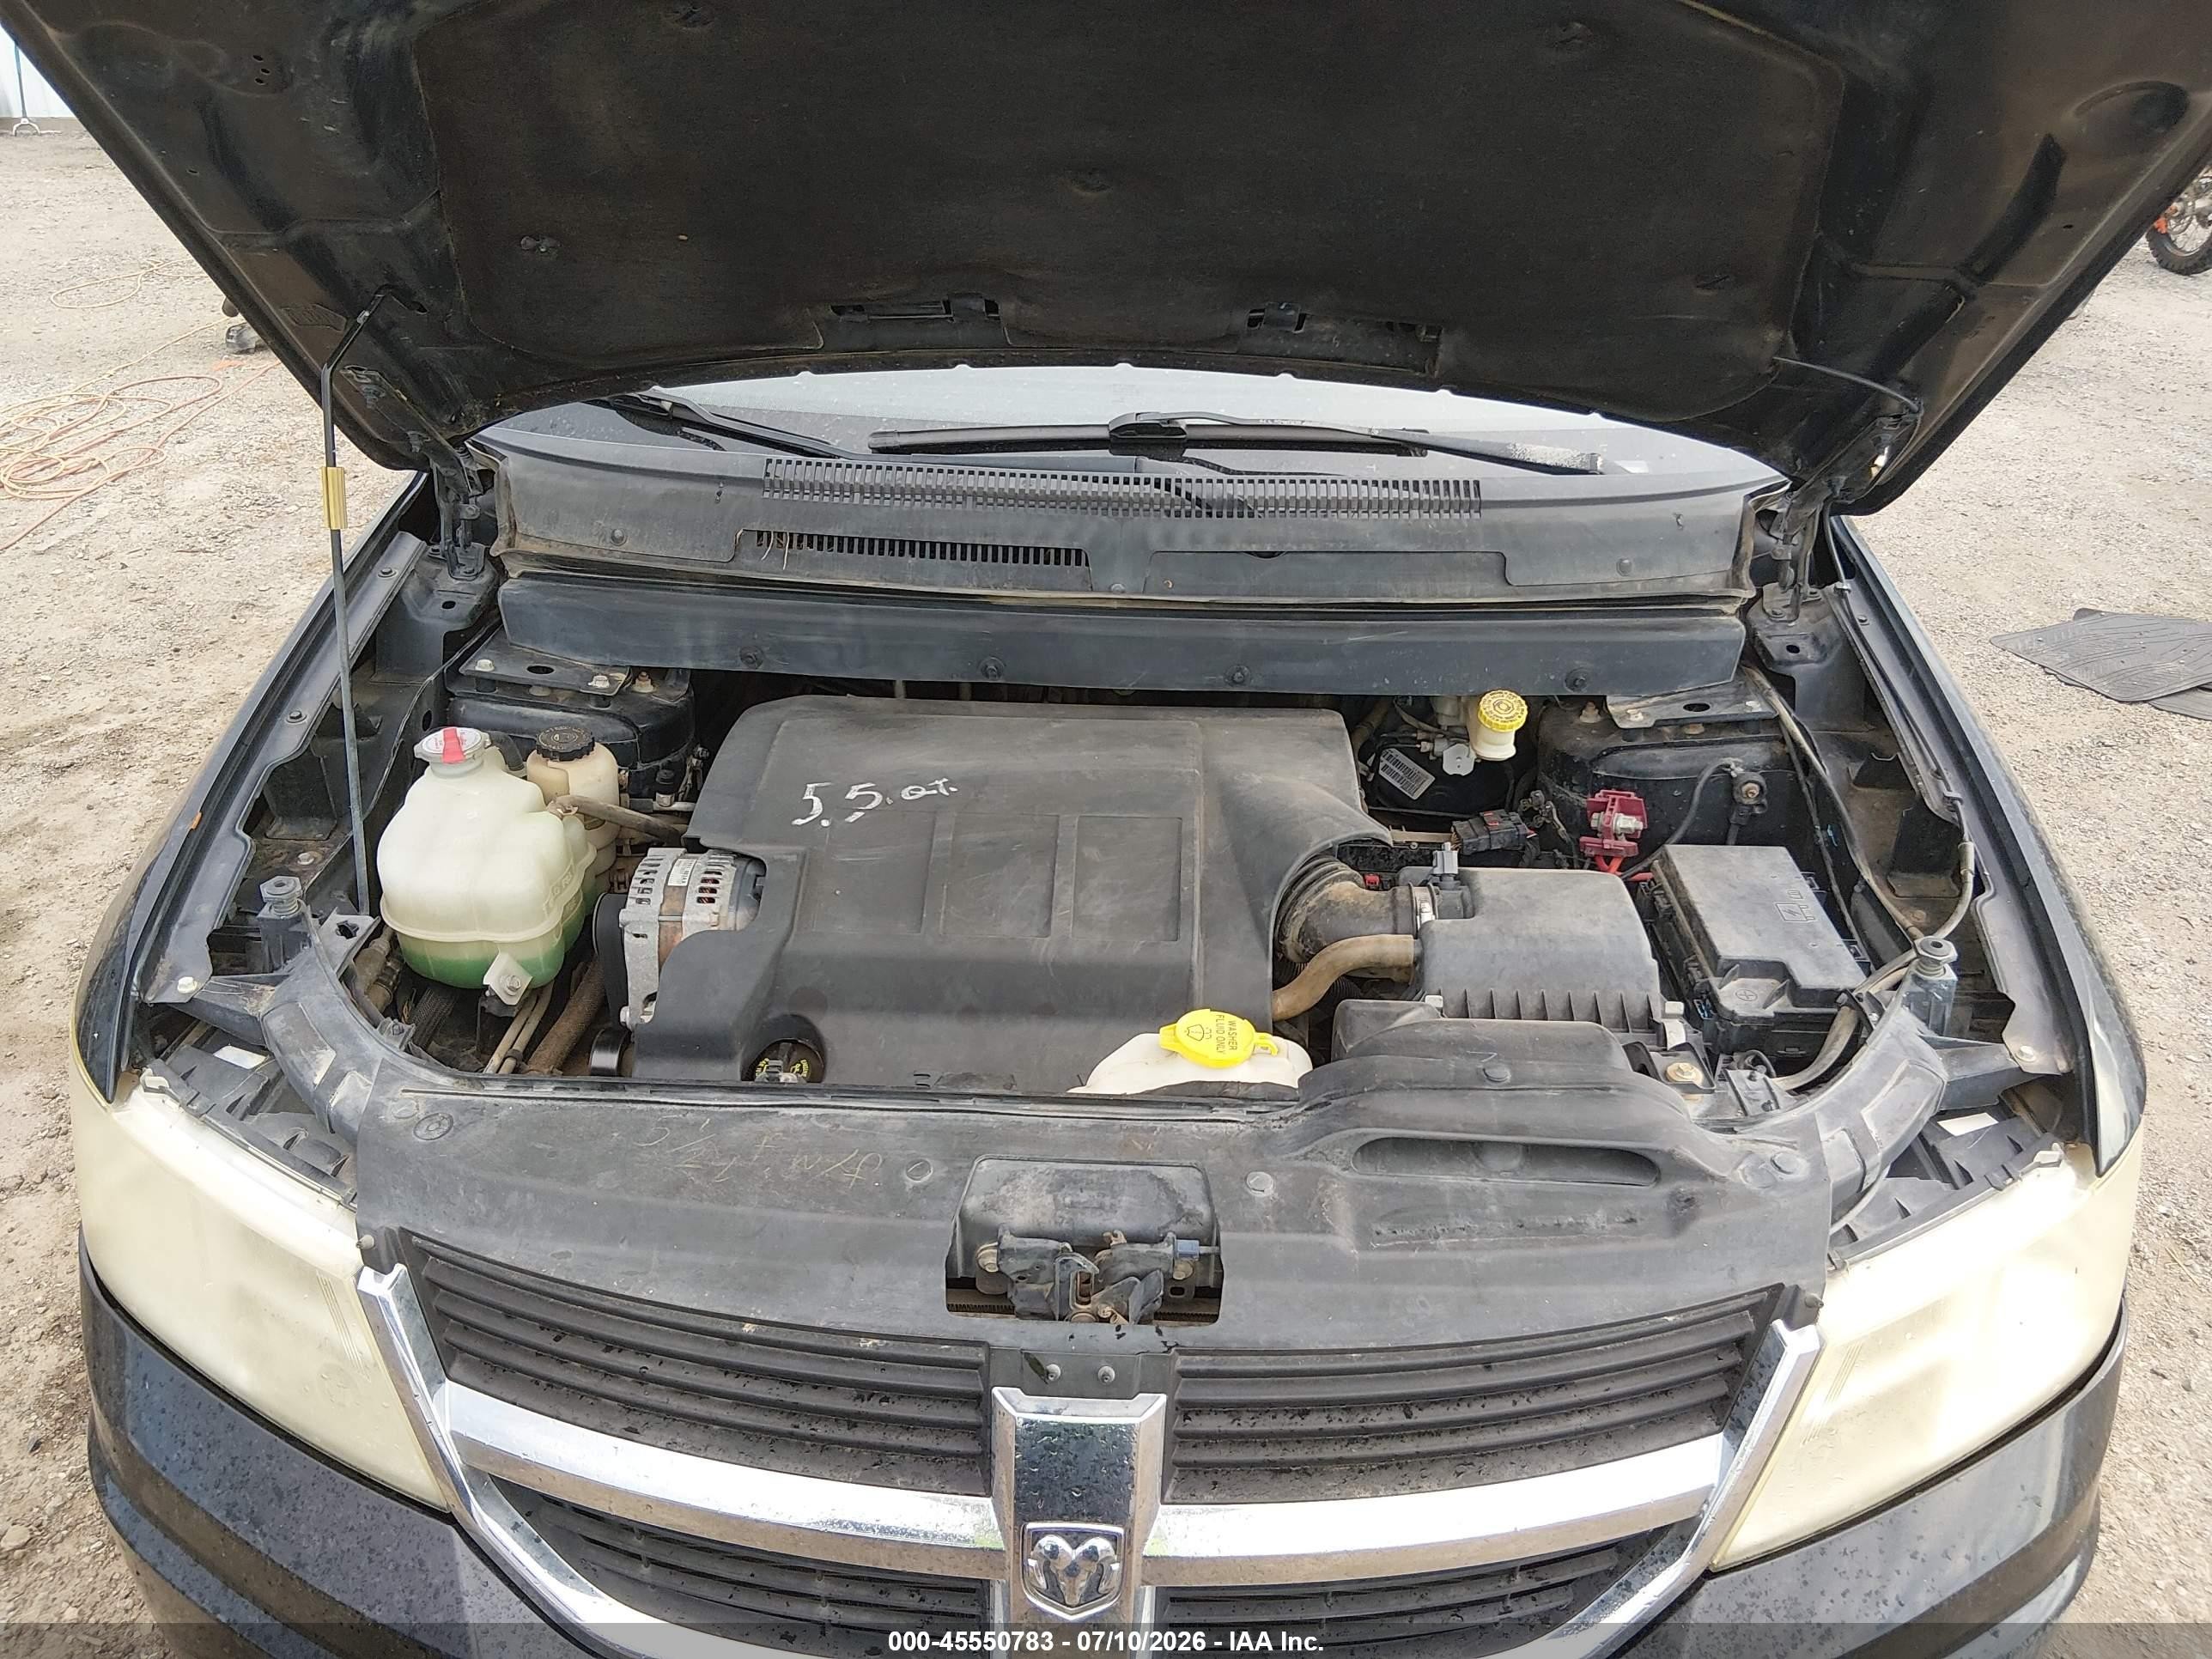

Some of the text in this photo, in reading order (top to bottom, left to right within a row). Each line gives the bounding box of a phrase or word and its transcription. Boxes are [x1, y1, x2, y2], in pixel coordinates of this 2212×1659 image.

[1216, 1014, 1226, 1054] FLUID ONLY
[1227, 1020, 1237, 1050] WASHER
